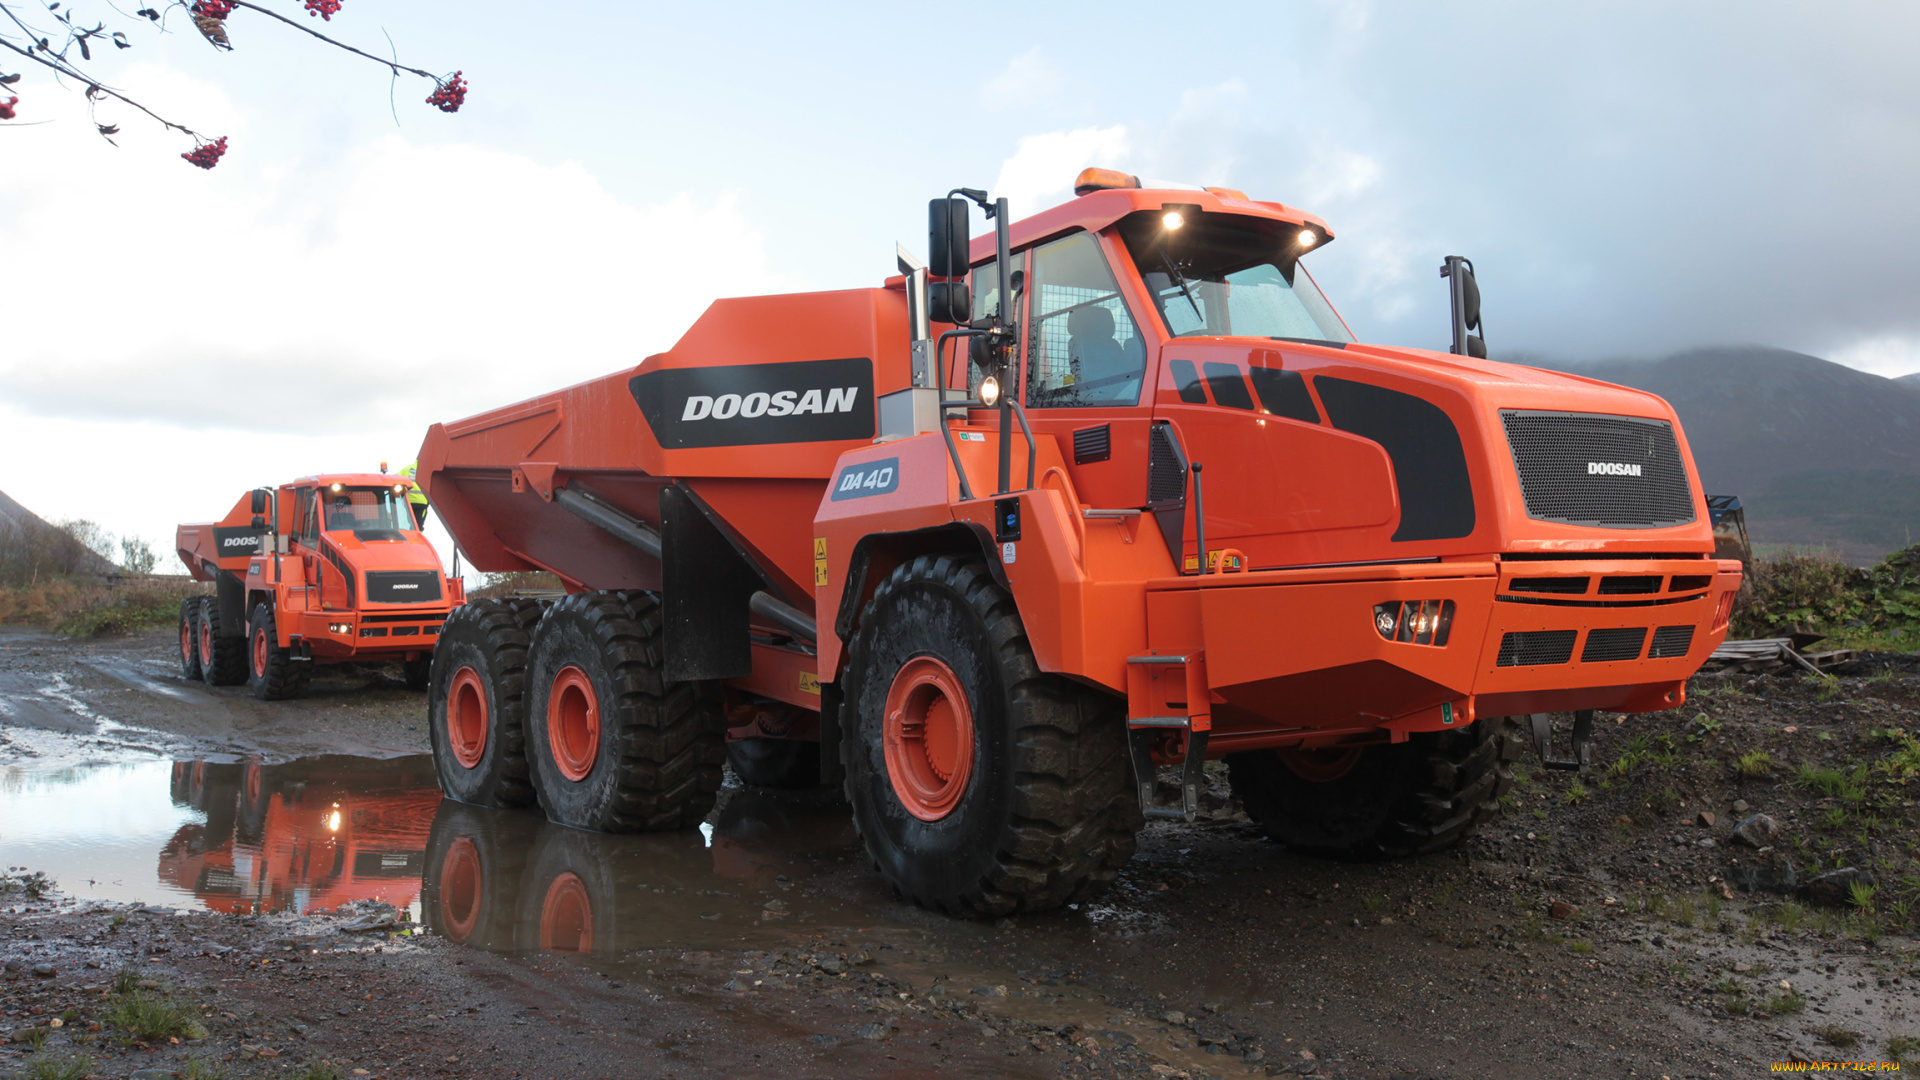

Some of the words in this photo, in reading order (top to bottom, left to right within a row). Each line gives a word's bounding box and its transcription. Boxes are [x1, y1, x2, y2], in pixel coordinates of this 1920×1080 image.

[681, 386, 859, 421] DOOSAN
[1588, 462, 1641, 476] DOOSAN
[224, 536, 258, 546] DOOS
